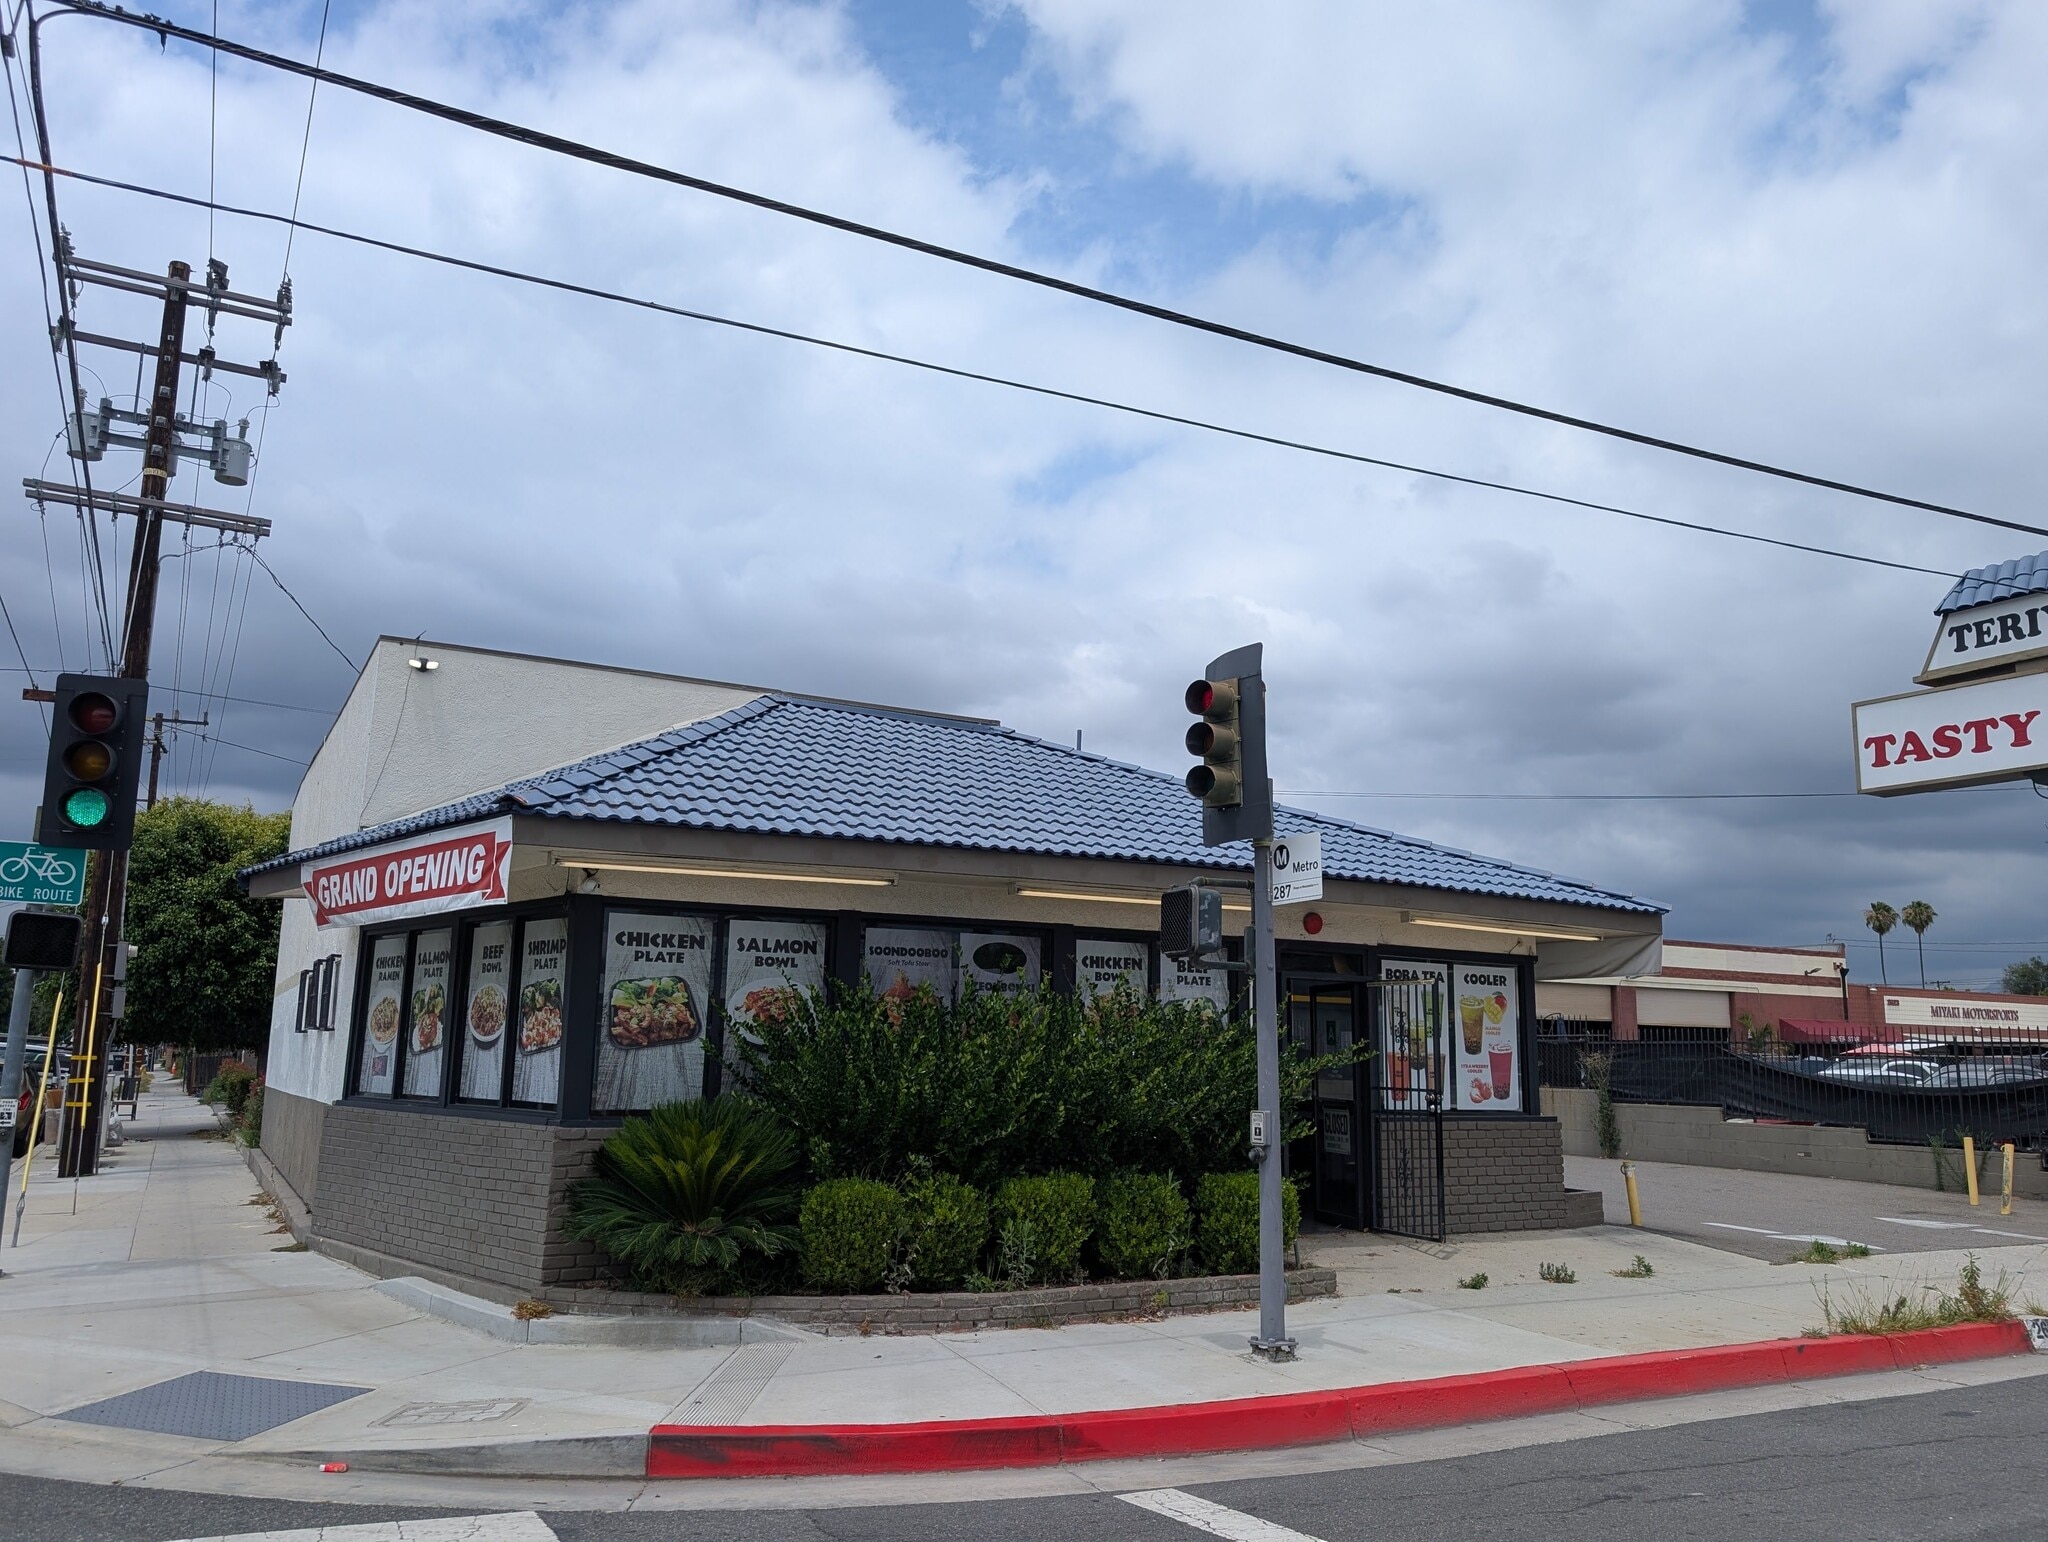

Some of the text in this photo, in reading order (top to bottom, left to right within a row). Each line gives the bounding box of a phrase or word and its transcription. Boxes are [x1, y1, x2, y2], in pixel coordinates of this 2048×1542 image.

[1947, 605, 2048, 653] TERI
[1863, 710, 2041, 768] TASTY
[1292, 860, 1319, 873] Metro
[317, 843, 487, 910] GRAND OPENING
[0, 885, 74, 901] BIKE ROUTE
[1273, 884, 1291, 900] 287
[528, 939, 566, 956] SHRIMP
[616, 930, 705, 950] CHICKEN
[736, 937, 818, 955] SALMON
[417, 951, 450, 966] SALMON
[482, 944, 504, 960] BEEF
[633, 950, 685, 964] PLATE
[869, 945, 948, 958] SOONDOOBOO
[376, 954, 406, 970] CHICKEN
[481, 961, 502, 973] BOWL
[534, 957, 558, 970] PLATE
[754, 956, 798, 968] BOWL
[1081, 955, 1143, 971] CHICKEN
[379, 971, 400, 982] RAMEN
[423, 967, 443, 978] PLATE
[1176, 975, 1211, 986] PLATE
[1385, 968, 1445, 983] BOBA TEA
[1463, 973, 1507, 987] COOLER
[1930, 1005, 2019, 1022] MIYAKI MOTORSPORTS
[1324, 1112, 1348, 1136] CLOSED
